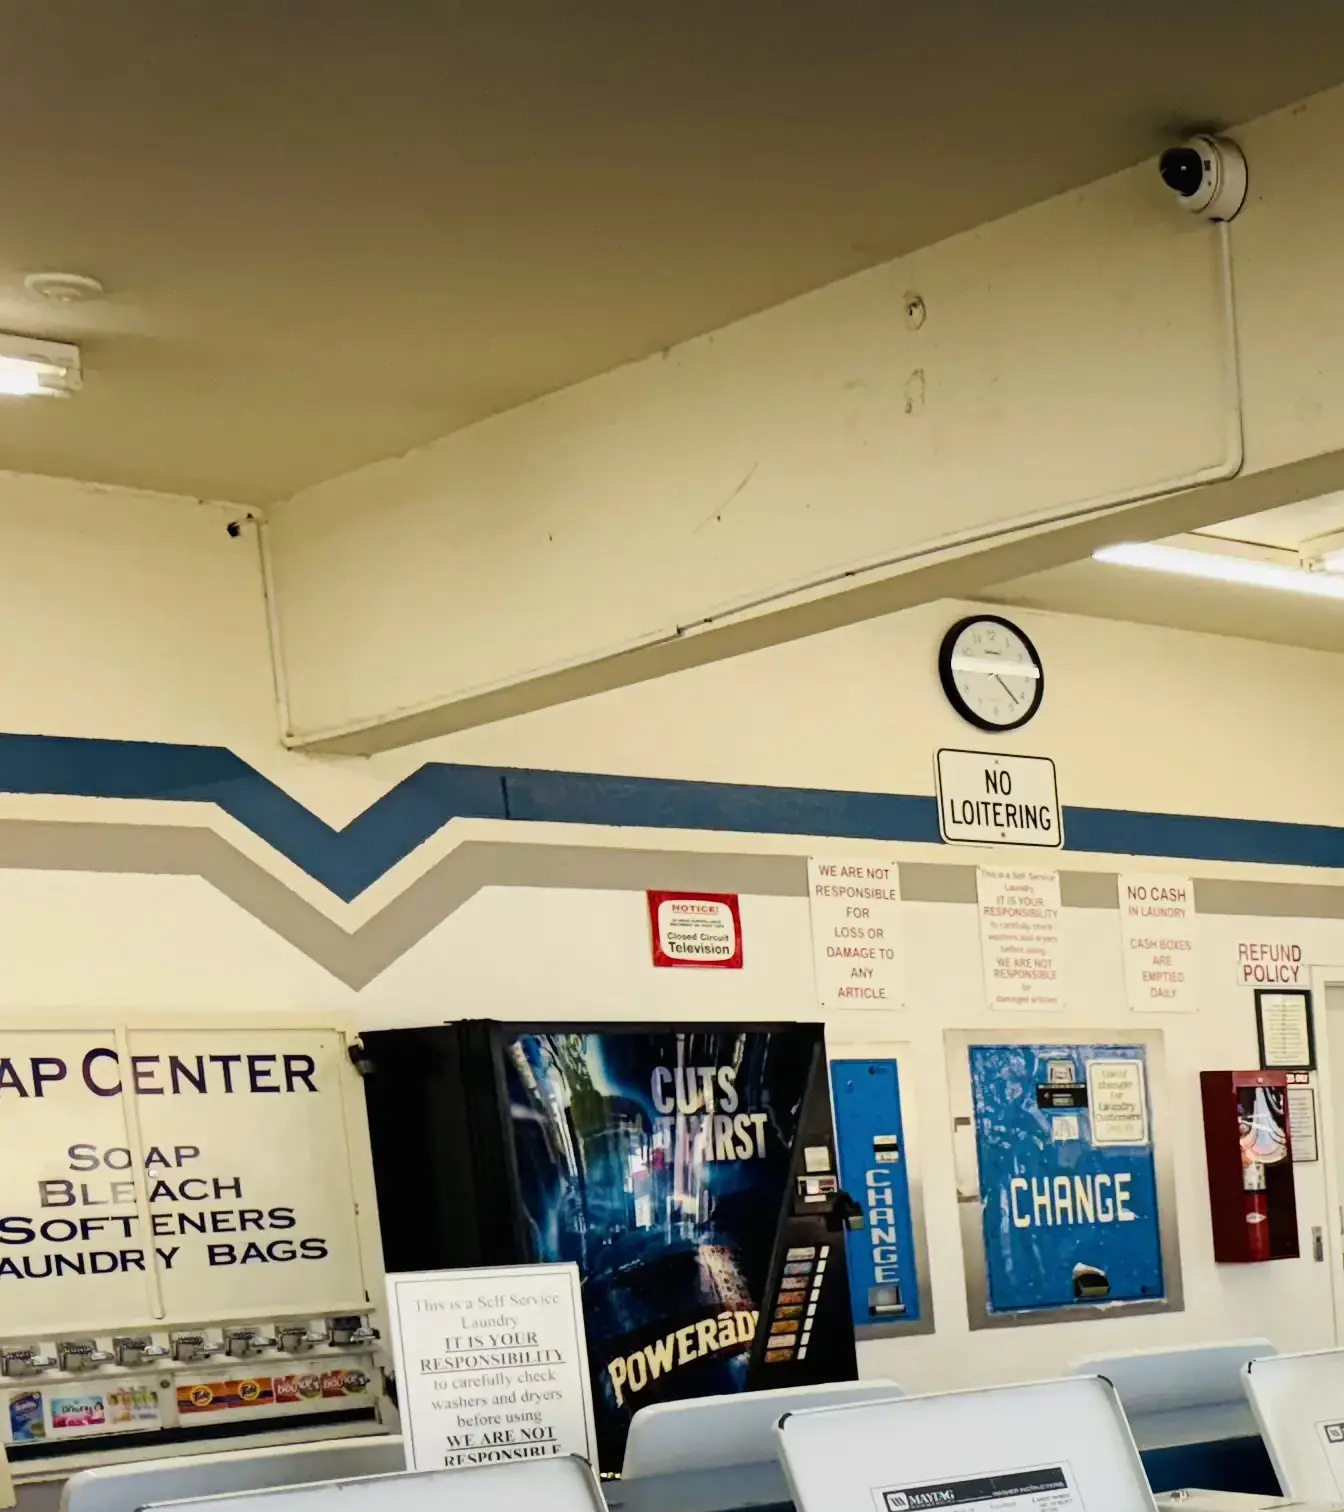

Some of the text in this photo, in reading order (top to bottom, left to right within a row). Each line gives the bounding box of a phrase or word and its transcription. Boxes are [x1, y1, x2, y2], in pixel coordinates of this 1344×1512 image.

[985, 769, 1012, 795] NO
[950, 799, 1051, 831] LOITERING
[818, 865, 890, 880] WE ARE NOT
[815, 885, 897, 900] RESPONSIBLE
[1127, 886, 1187, 903] NO CASH
[846, 906, 870, 919] FOR
[983, 906, 1059, 919] RESPONSIBILITY
[1128, 906, 1186, 918] IN LAUNDRY
[667, 931, 729, 942] Closed Circuit
[834, 926, 885, 939] LOSS OR
[668, 941, 730, 955] Television
[826, 946, 895, 960] DAMAGE TO
[1130, 938, 1192, 951] CASH BOXES
[1238, 943, 1302, 962] REFUND
[1152, 955, 1173, 966] ARE
[850, 967, 874, 979] ANY
[993, 968, 1057, 981] RESPONSIBLE
[1142, 970, 1185, 983] EMPTIED
[1243, 964, 1300, 983] POLICY
[1150, 987, 1177, 999] DAILY
[0, 1047, 319, 1098] AP CENTER
[650, 1065, 739, 1115] CUTS
[654, 1113, 768, 1162] THIRST
[68, 1143, 200, 1172] SOAP
[38, 1176, 243, 1208] BLEACH
[1010, 1172, 1136, 1228] CHANGE
[0, 1207, 296, 1245] SOFTENERS
[866, 1168, 900, 1284] CHANGE
[0, 1238, 329, 1279] AUNDRY BAGS
[415, 1292, 561, 1313] This is a Self Service
[461, 1313, 519, 1330] Laundry
[445, 1331, 539, 1350] IT IS YOUR
[420, 1349, 564, 1372] RESPONSIBILITY
[433, 1369, 557, 1391] to carefully check
[431, 1389, 563, 1411] washers and dryers
[456, 1411, 543, 1428] before using
[446, 1426, 556, 1448] WE ARE NOT
[908, 1489, 955, 1506] MAYTAG
